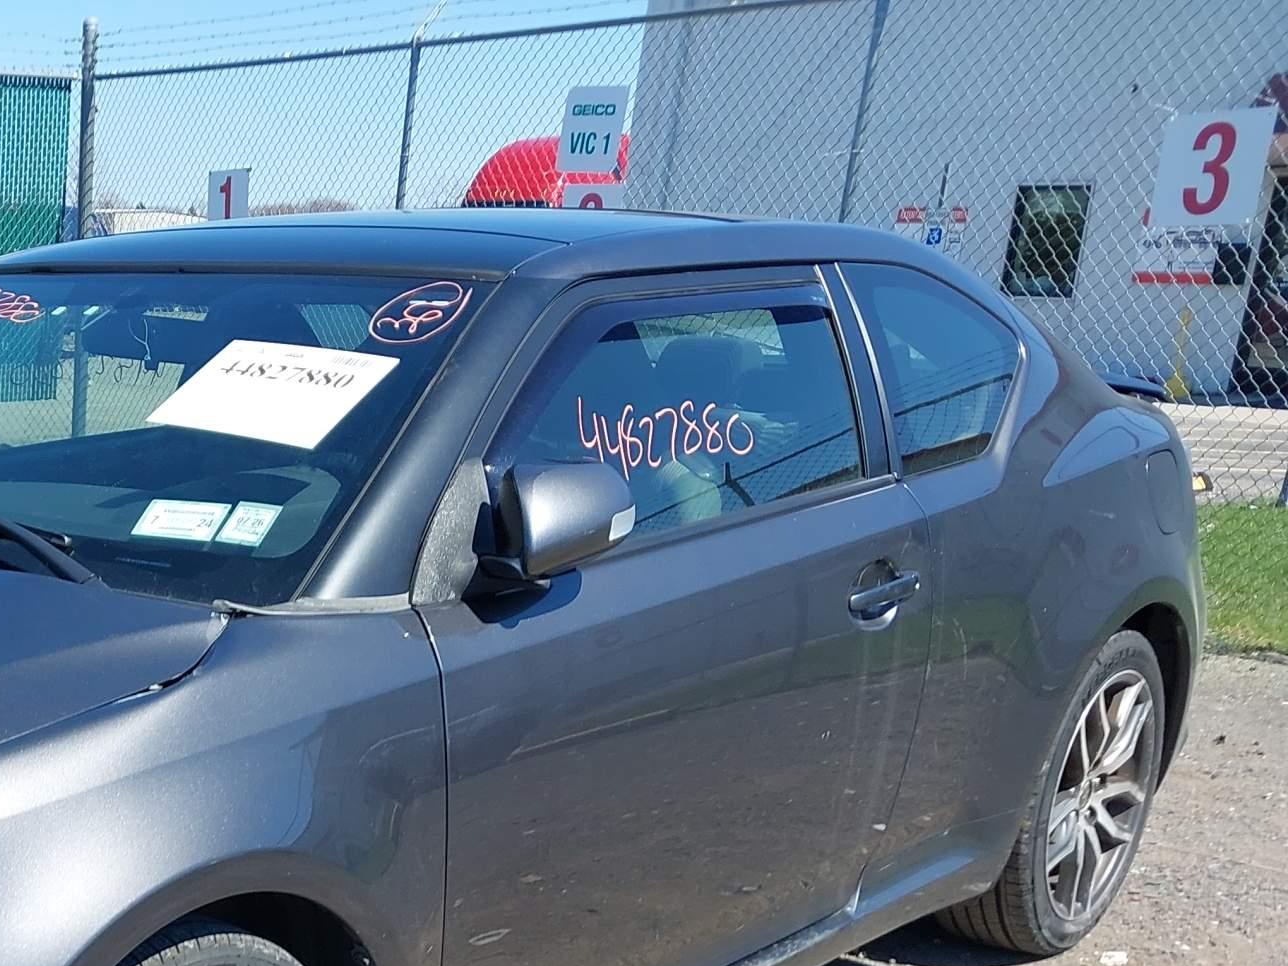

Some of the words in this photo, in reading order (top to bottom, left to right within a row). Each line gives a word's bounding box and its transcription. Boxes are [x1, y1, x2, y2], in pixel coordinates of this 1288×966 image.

[572, 104, 616, 116] GEICO
[569, 132, 597, 155] VIC
[602, 132, 611, 155] 1
[1183, 121, 1237, 216] 3
[219, 175, 232, 219] 1
[220, 360, 356, 389] 44827880
[577, 396, 754, 481] 44827880
